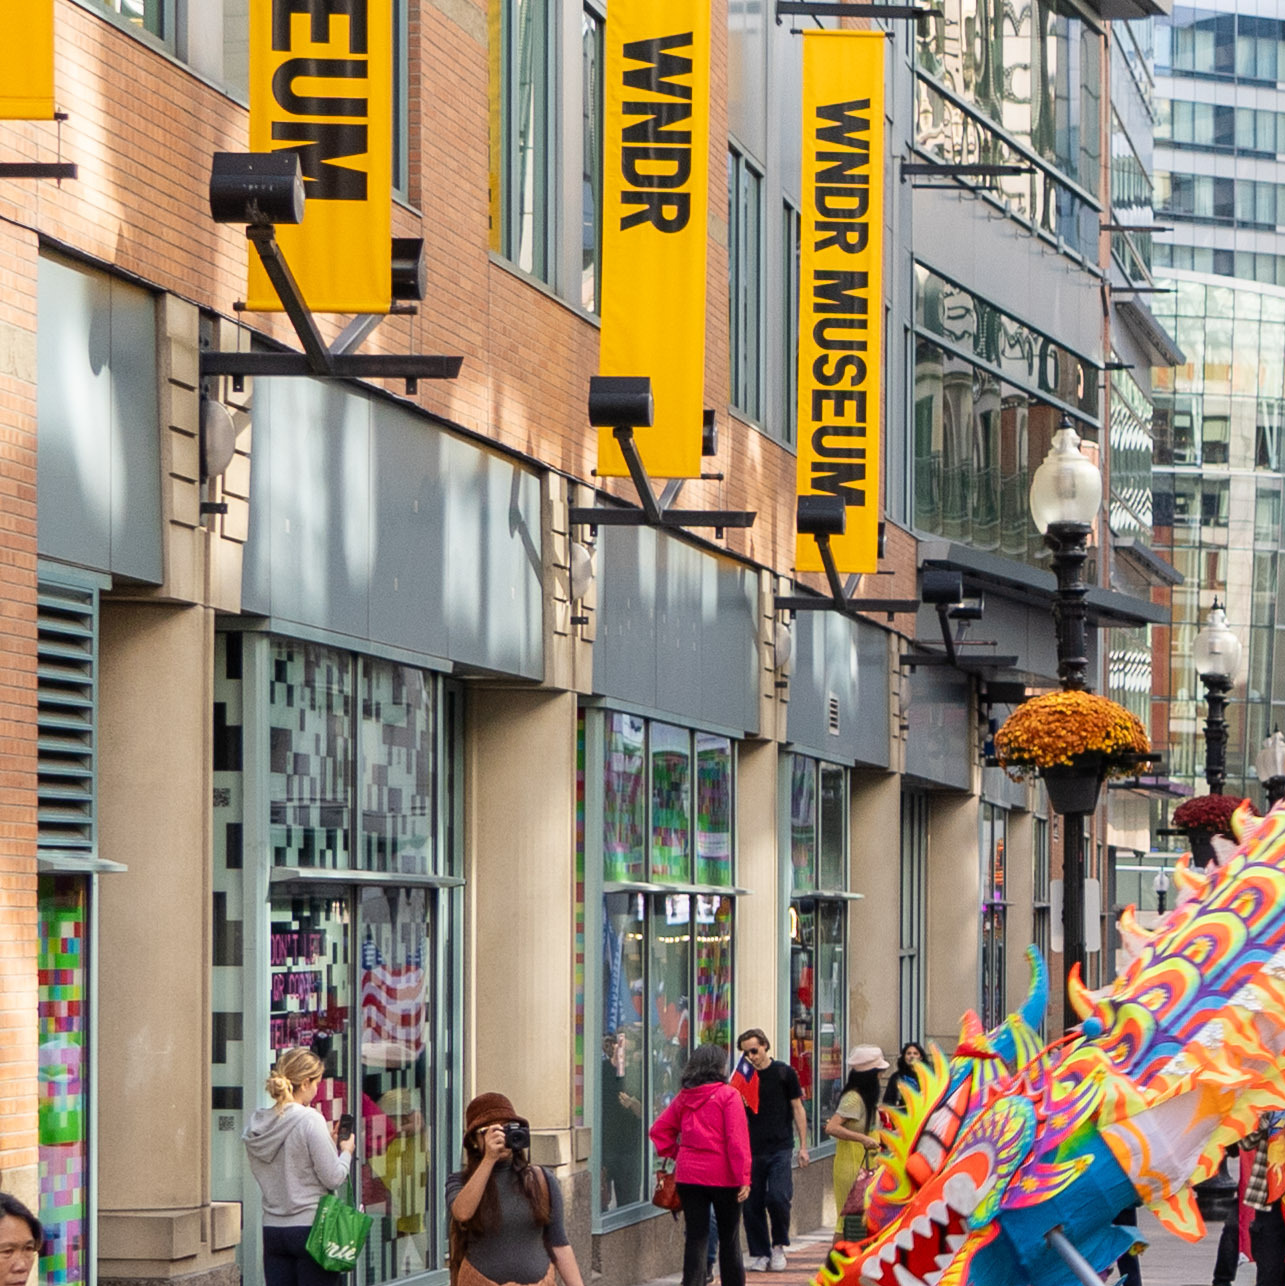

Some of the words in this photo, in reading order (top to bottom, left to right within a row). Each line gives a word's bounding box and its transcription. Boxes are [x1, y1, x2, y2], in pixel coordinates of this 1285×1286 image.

[620, 31, 693, 234] WNDR
[814, 98, 871, 254] WNDR
[811, 269, 870, 507] MUSEUM
